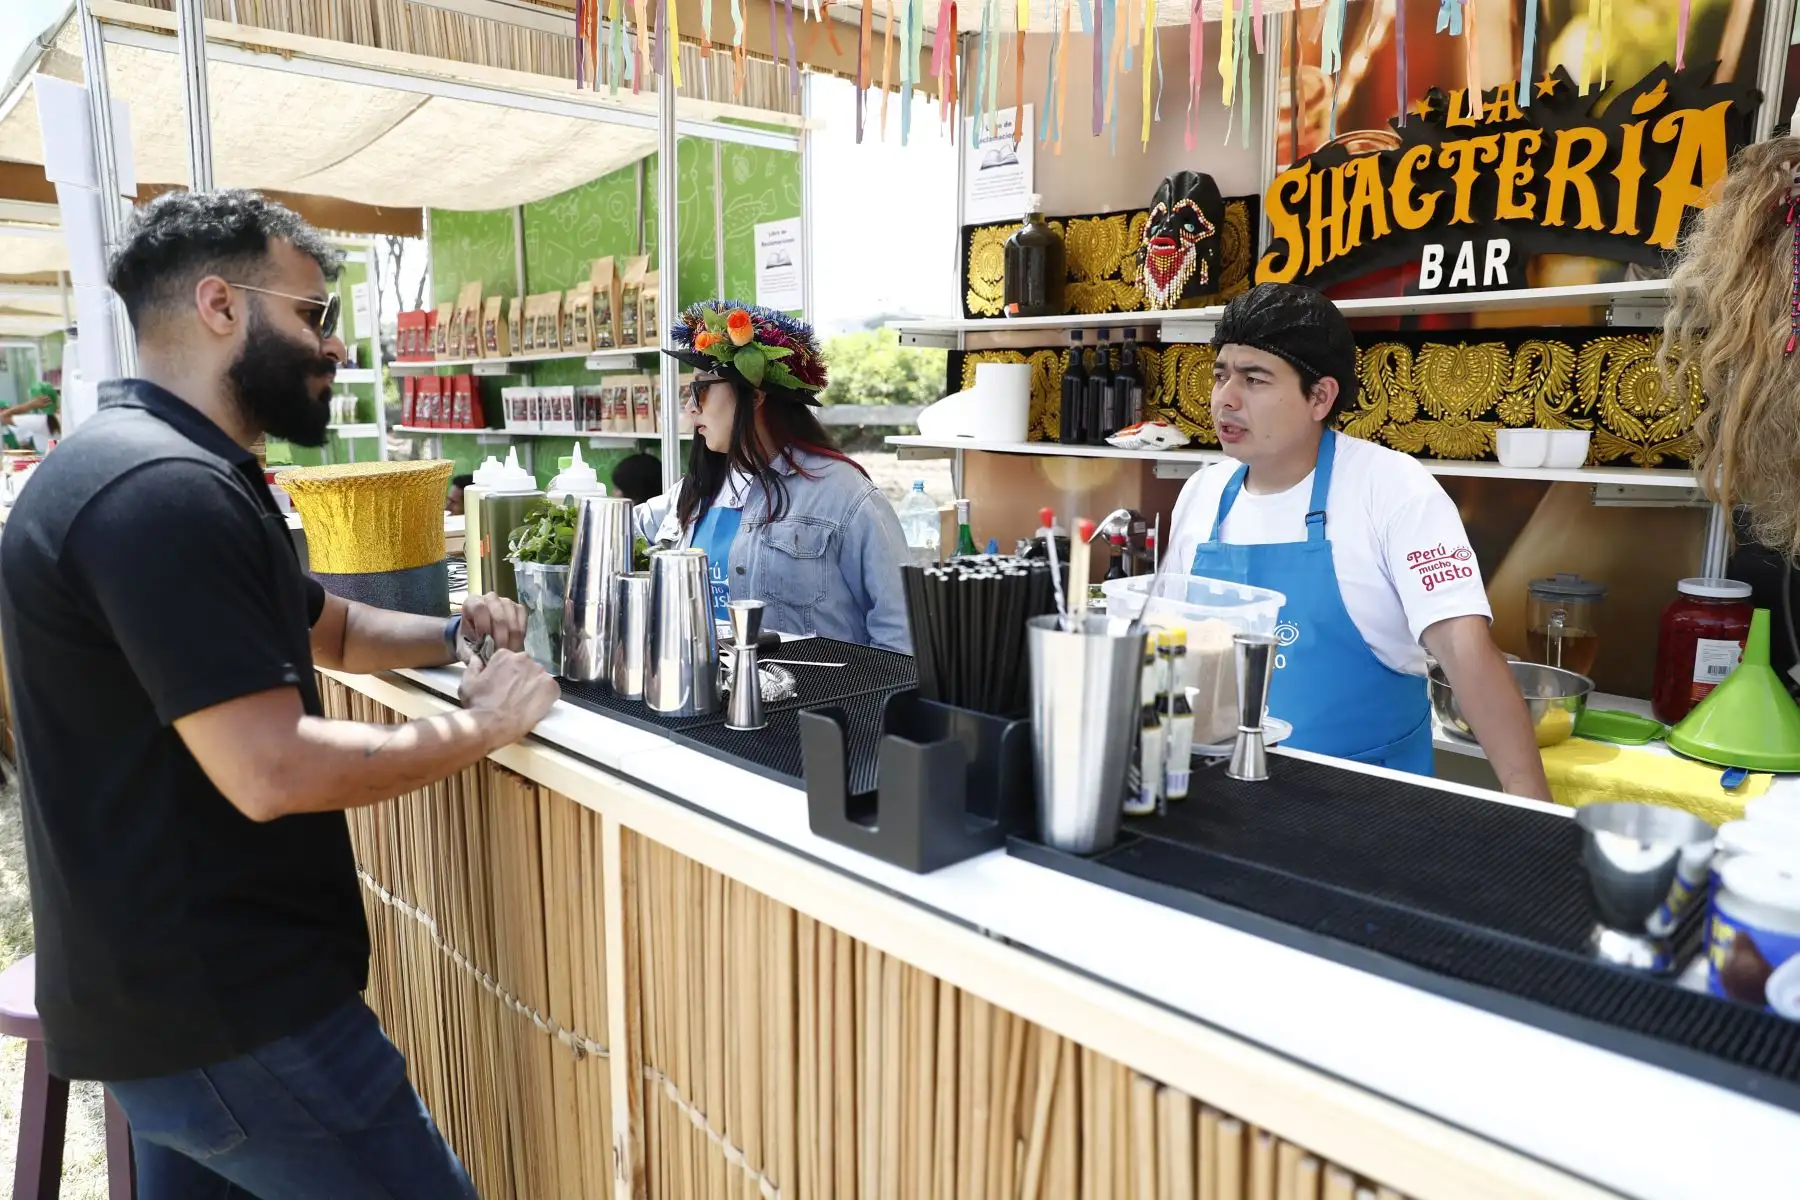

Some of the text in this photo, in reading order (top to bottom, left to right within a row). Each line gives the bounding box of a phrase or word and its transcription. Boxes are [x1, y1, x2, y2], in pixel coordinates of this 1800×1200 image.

[1446, 80, 1524, 128] LA
[1419, 238, 1511, 290] BAR
[1407, 543, 1446, 563] Perú
[1419, 561, 1452, 574] mucho
[1422, 565, 1472, 591] gusto
